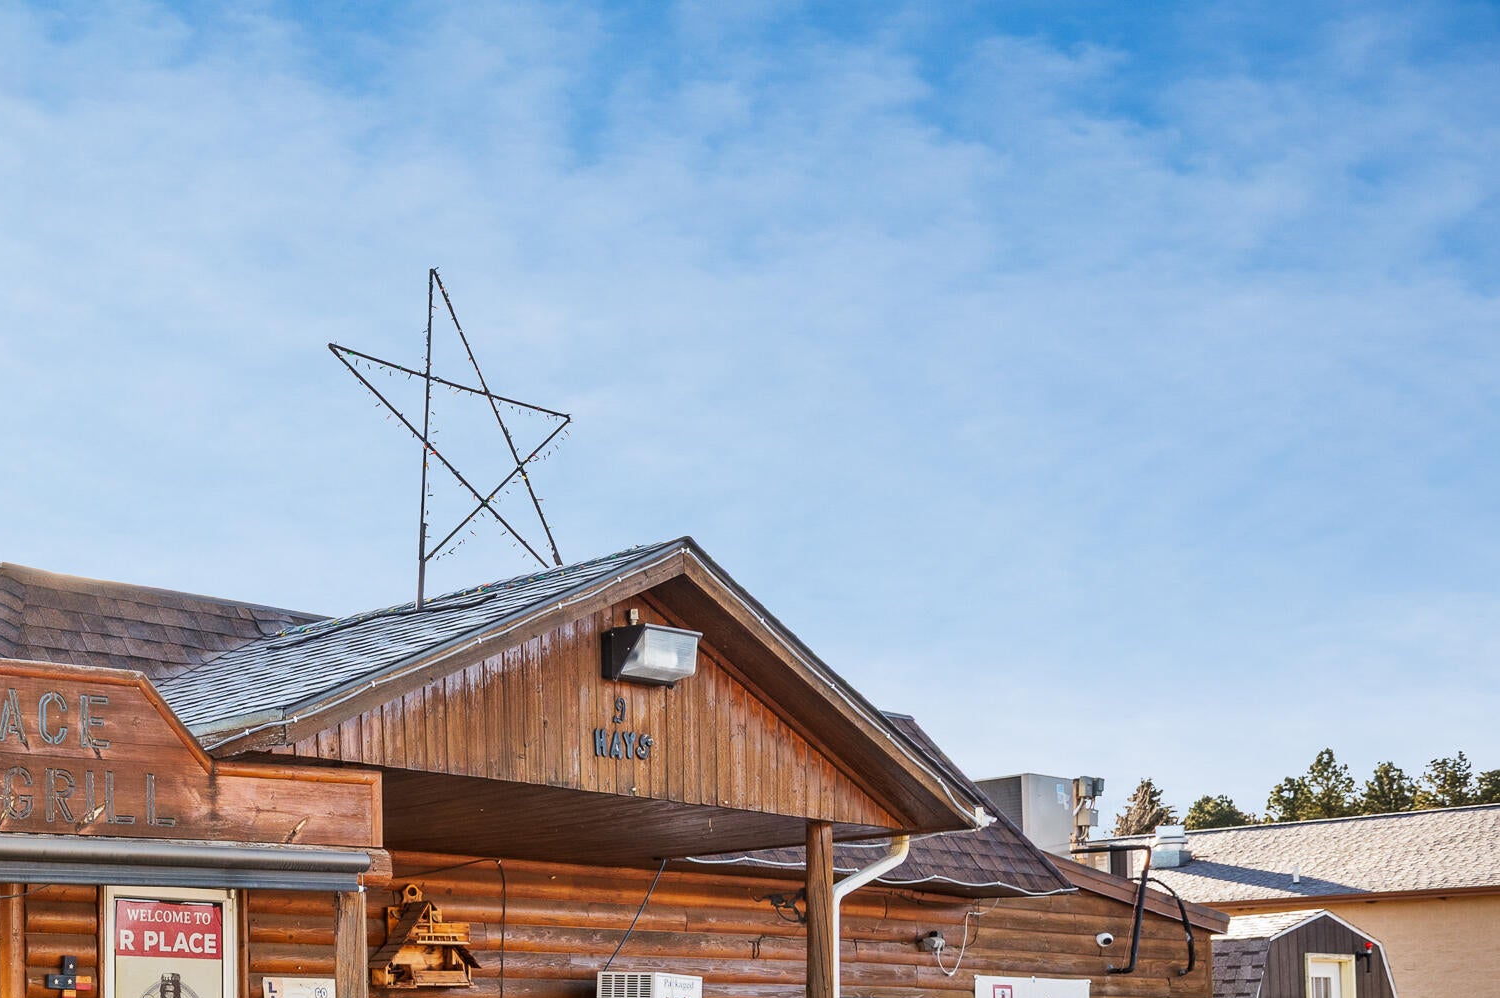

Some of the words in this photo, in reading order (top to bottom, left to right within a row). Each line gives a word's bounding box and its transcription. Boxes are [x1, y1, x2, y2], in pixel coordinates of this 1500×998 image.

[593, 728, 654, 760] HAYS
[2, 765, 176, 827] GRILL
[127, 908, 191, 924] WELCOME
[194, 912, 211, 925] TO
[120, 929, 135, 951] R
[144, 930, 217, 954] PLACE
[663, 979, 694, 990] Pakaged
